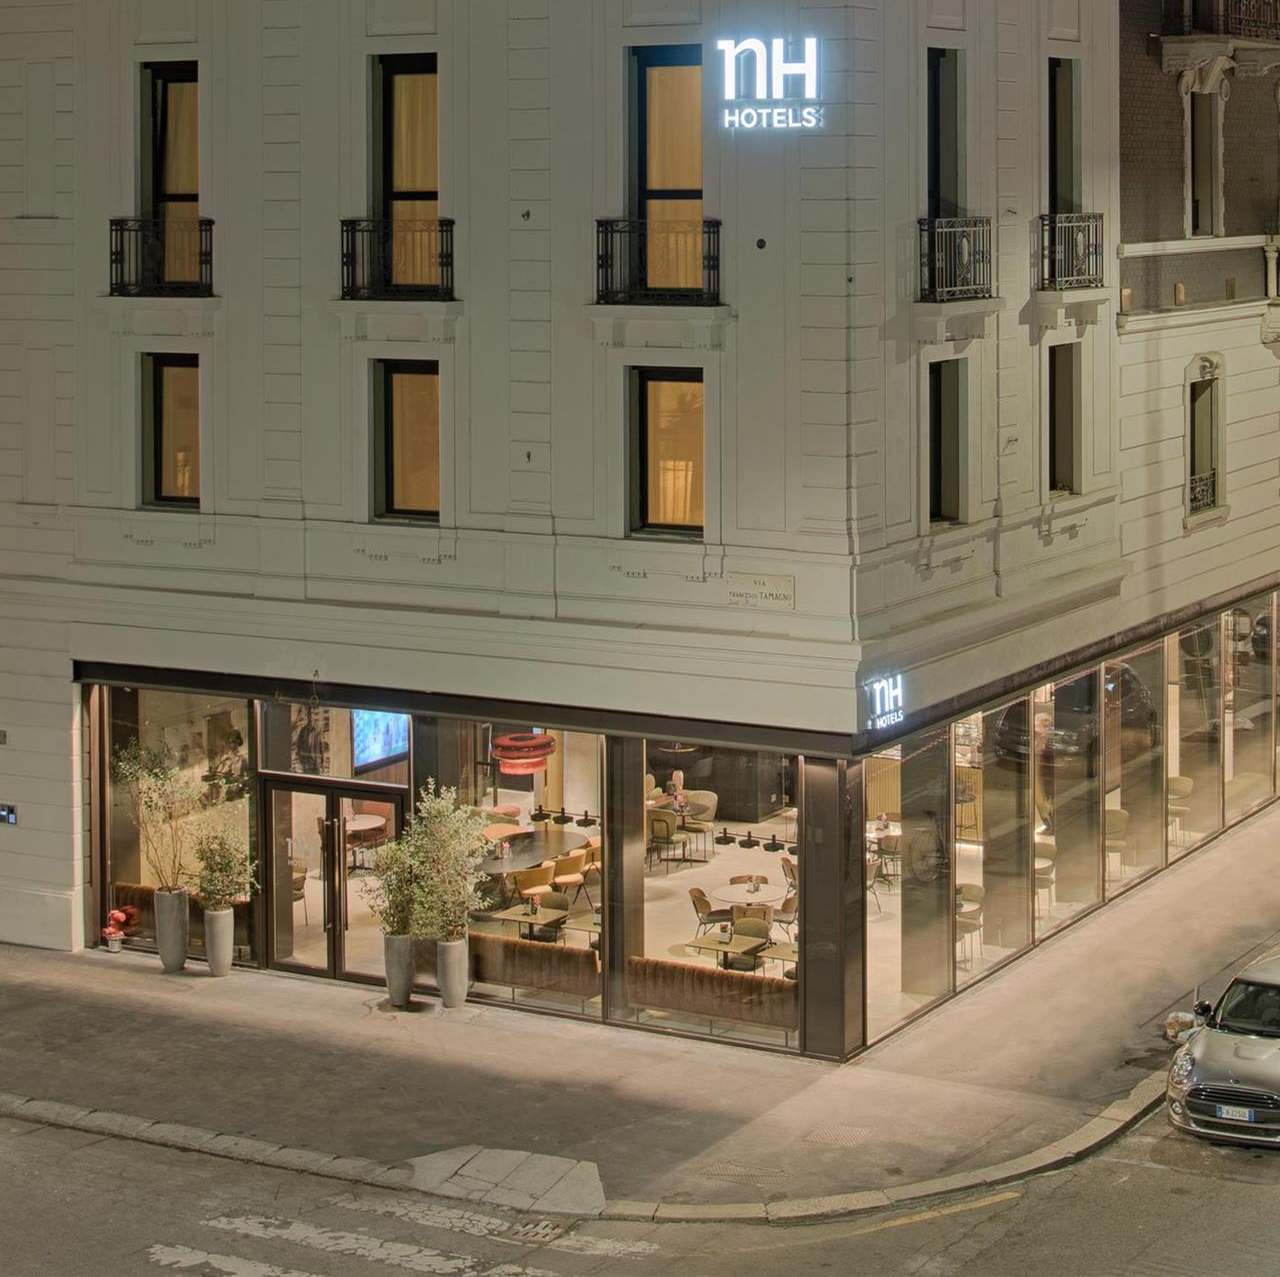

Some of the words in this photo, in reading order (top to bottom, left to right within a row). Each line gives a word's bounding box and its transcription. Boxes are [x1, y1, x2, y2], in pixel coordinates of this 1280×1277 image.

[723, 107, 818, 129] HOTELS
[753, 579, 767, 587] VIA
[876, 710, 904, 729] HOTELS
